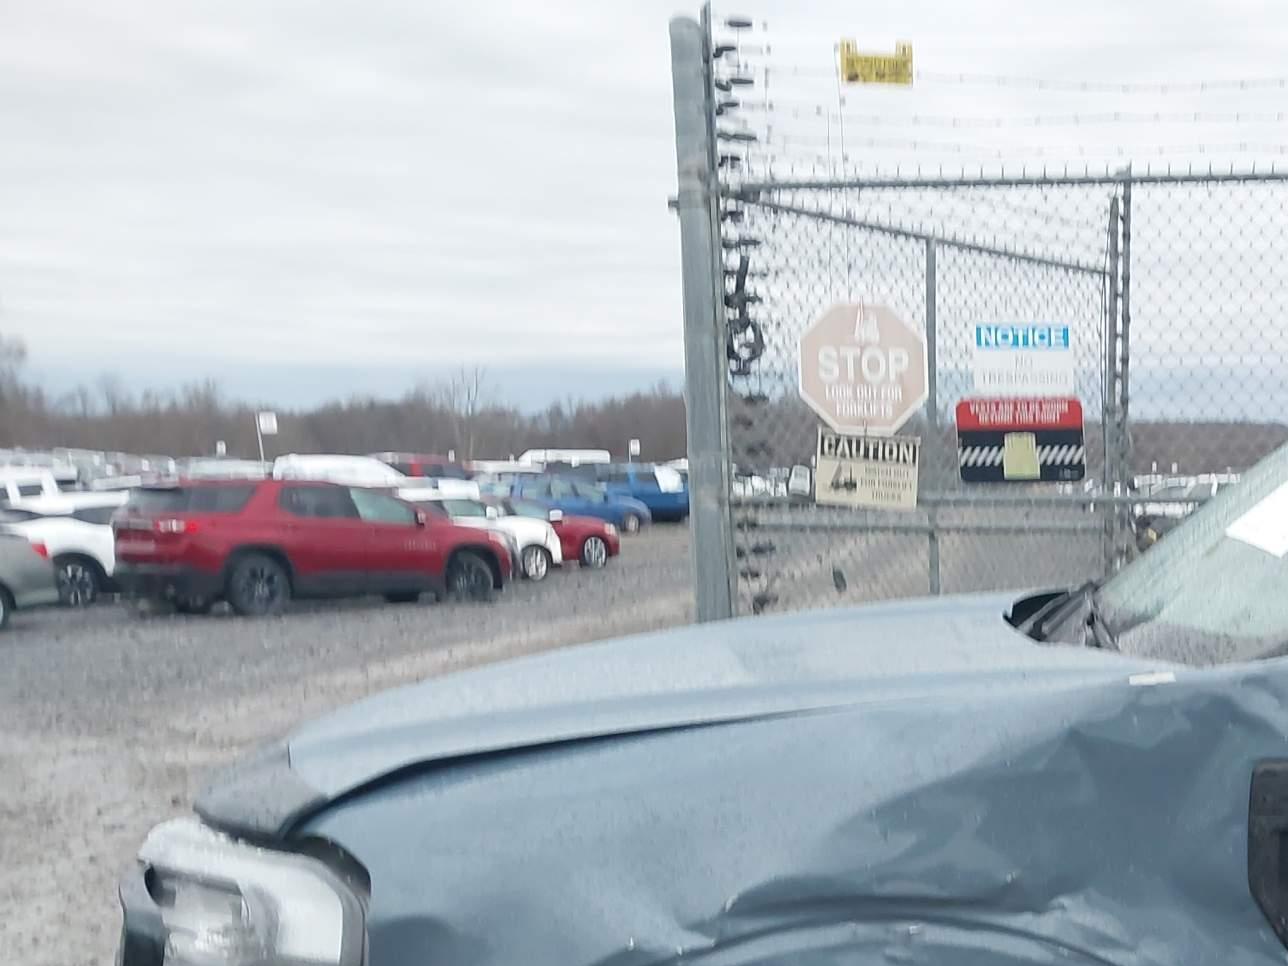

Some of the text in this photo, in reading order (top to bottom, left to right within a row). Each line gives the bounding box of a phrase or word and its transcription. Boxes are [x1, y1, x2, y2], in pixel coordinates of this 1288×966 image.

[980, 326, 1064, 346] NOTICE
[818, 346, 909, 384] STOP
[823, 436, 914, 465] CAUTION
